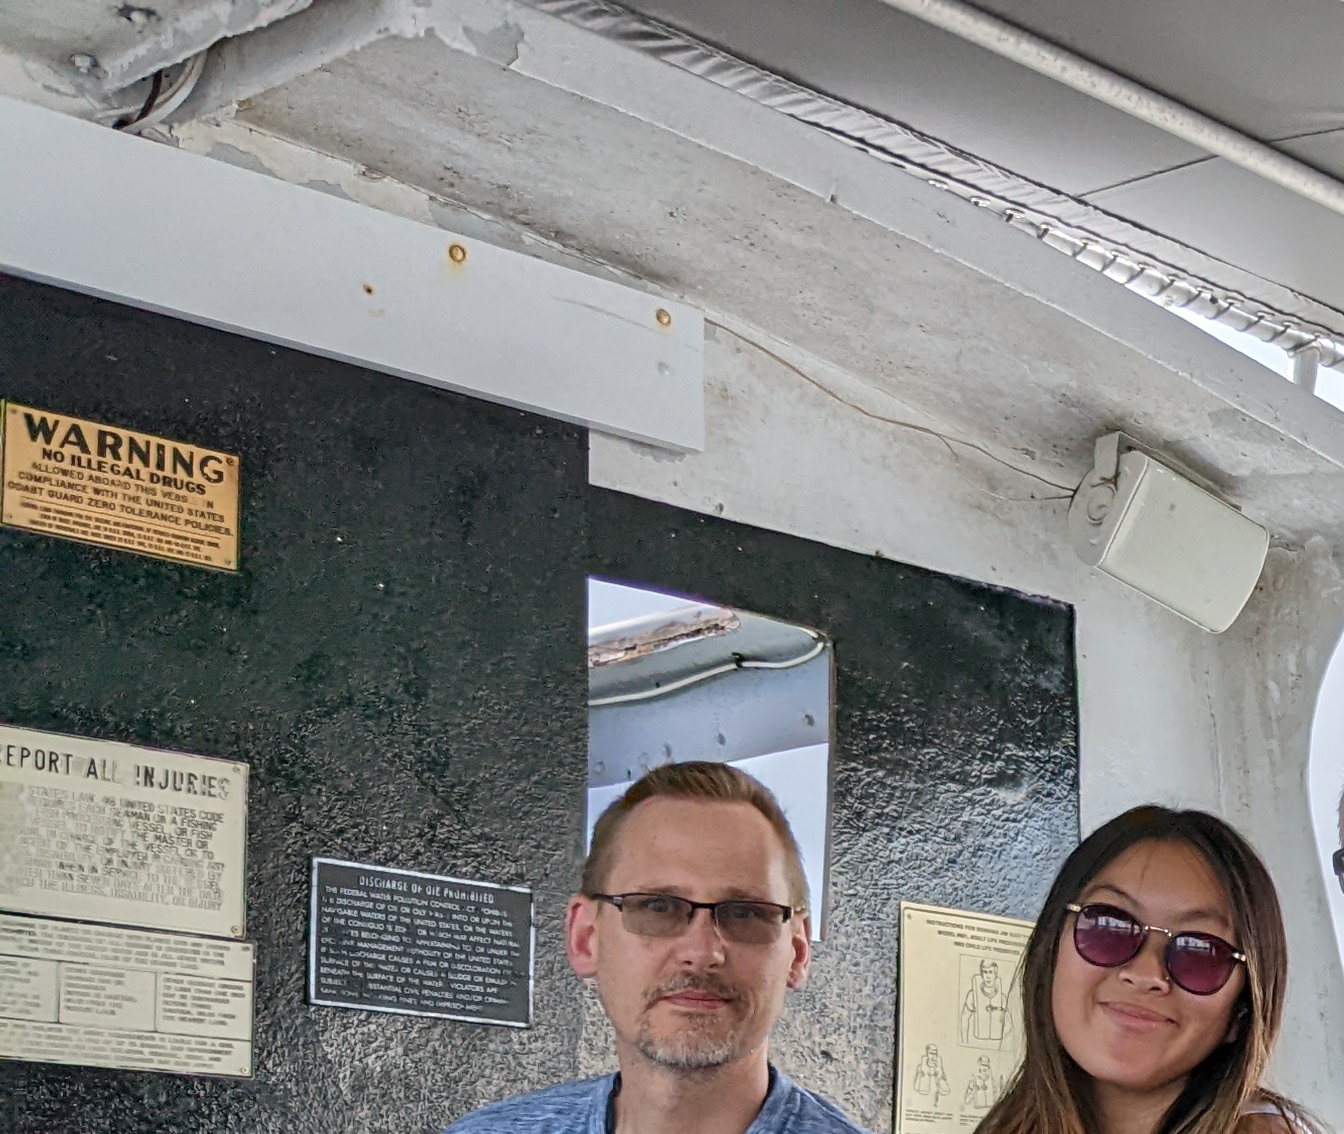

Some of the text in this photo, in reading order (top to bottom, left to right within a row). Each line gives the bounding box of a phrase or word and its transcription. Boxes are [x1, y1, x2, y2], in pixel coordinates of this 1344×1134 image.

[24, 412, 224, 484] WARNING
[41, 447, 207, 496] NO ILLEGAL DRUGS
[18, 471, 225, 523] COMPLIANCE WITH THE UNITED STATES
[32, 462, 84, 481] ALLOWED
[134, 483, 158, 497] THIS
[7, 481, 234, 537] COAST GUARD ZERO TOLERANCE POLICIES.
[0, 744, 74, 775] EPORT
[135, 763, 230, 801] INJURIES
